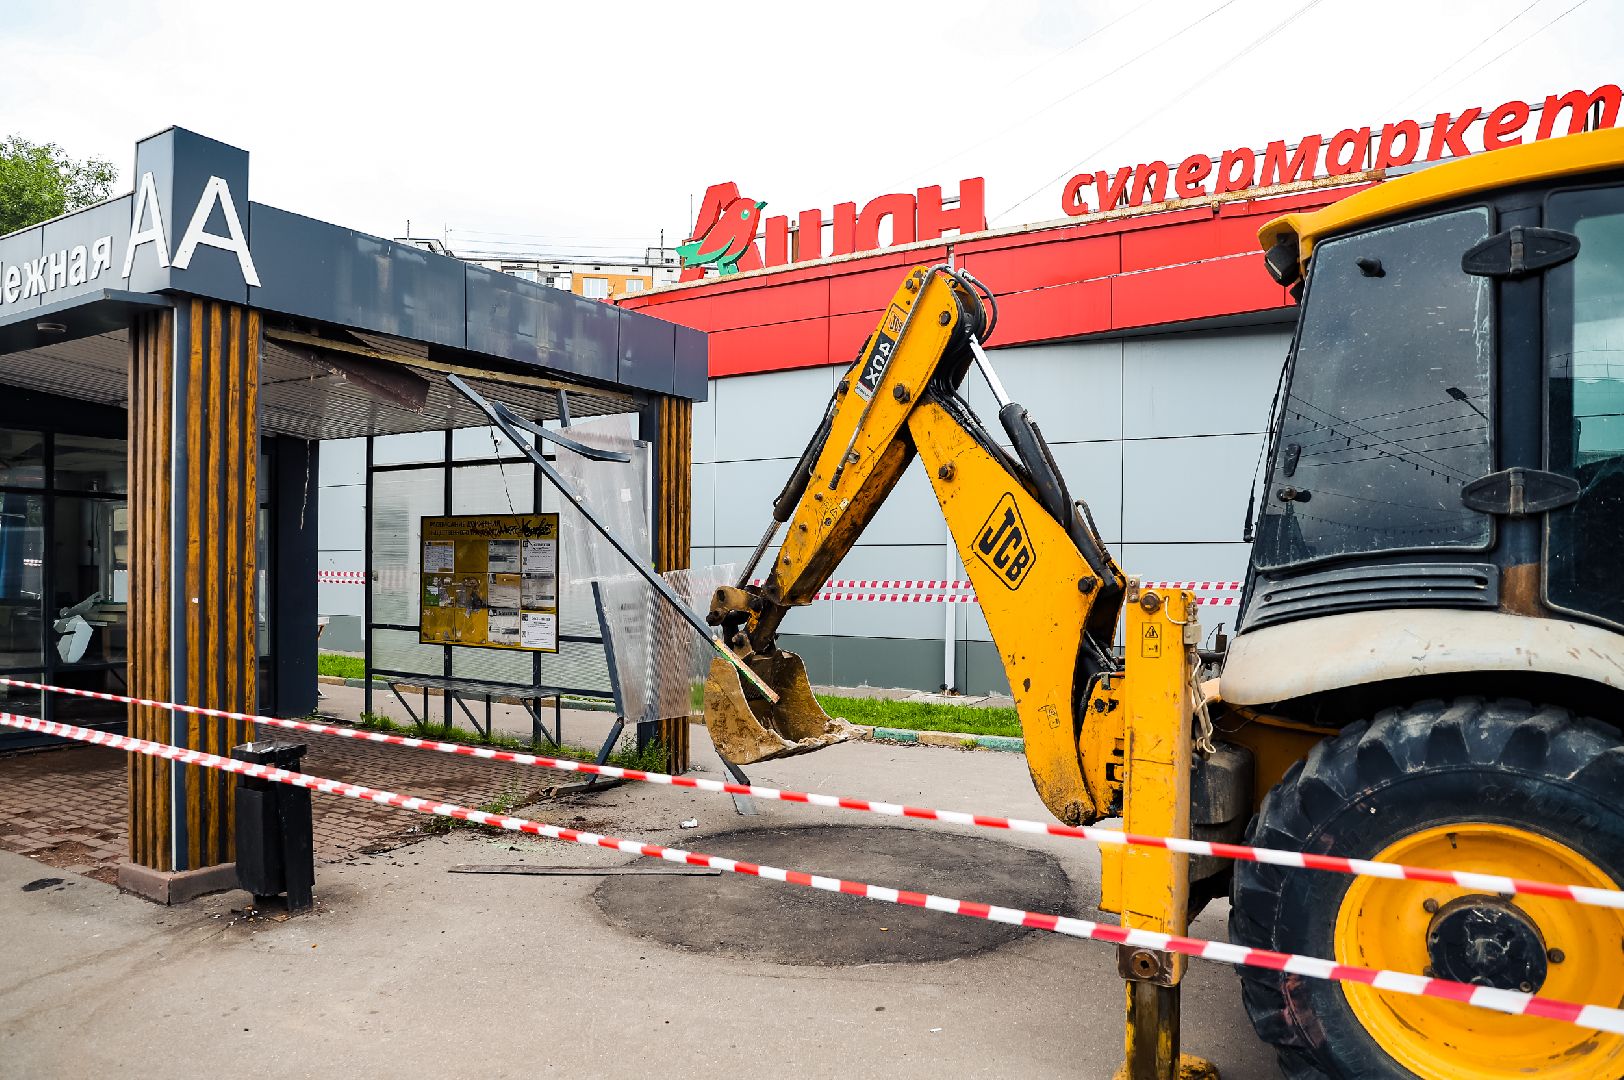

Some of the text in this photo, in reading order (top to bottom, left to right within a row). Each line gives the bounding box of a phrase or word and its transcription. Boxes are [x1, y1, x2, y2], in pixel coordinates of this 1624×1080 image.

[1062, 84, 1622, 217] супермаркет
[0, 235, 113, 305] ежная
[978, 506, 1030, 582] JCB
